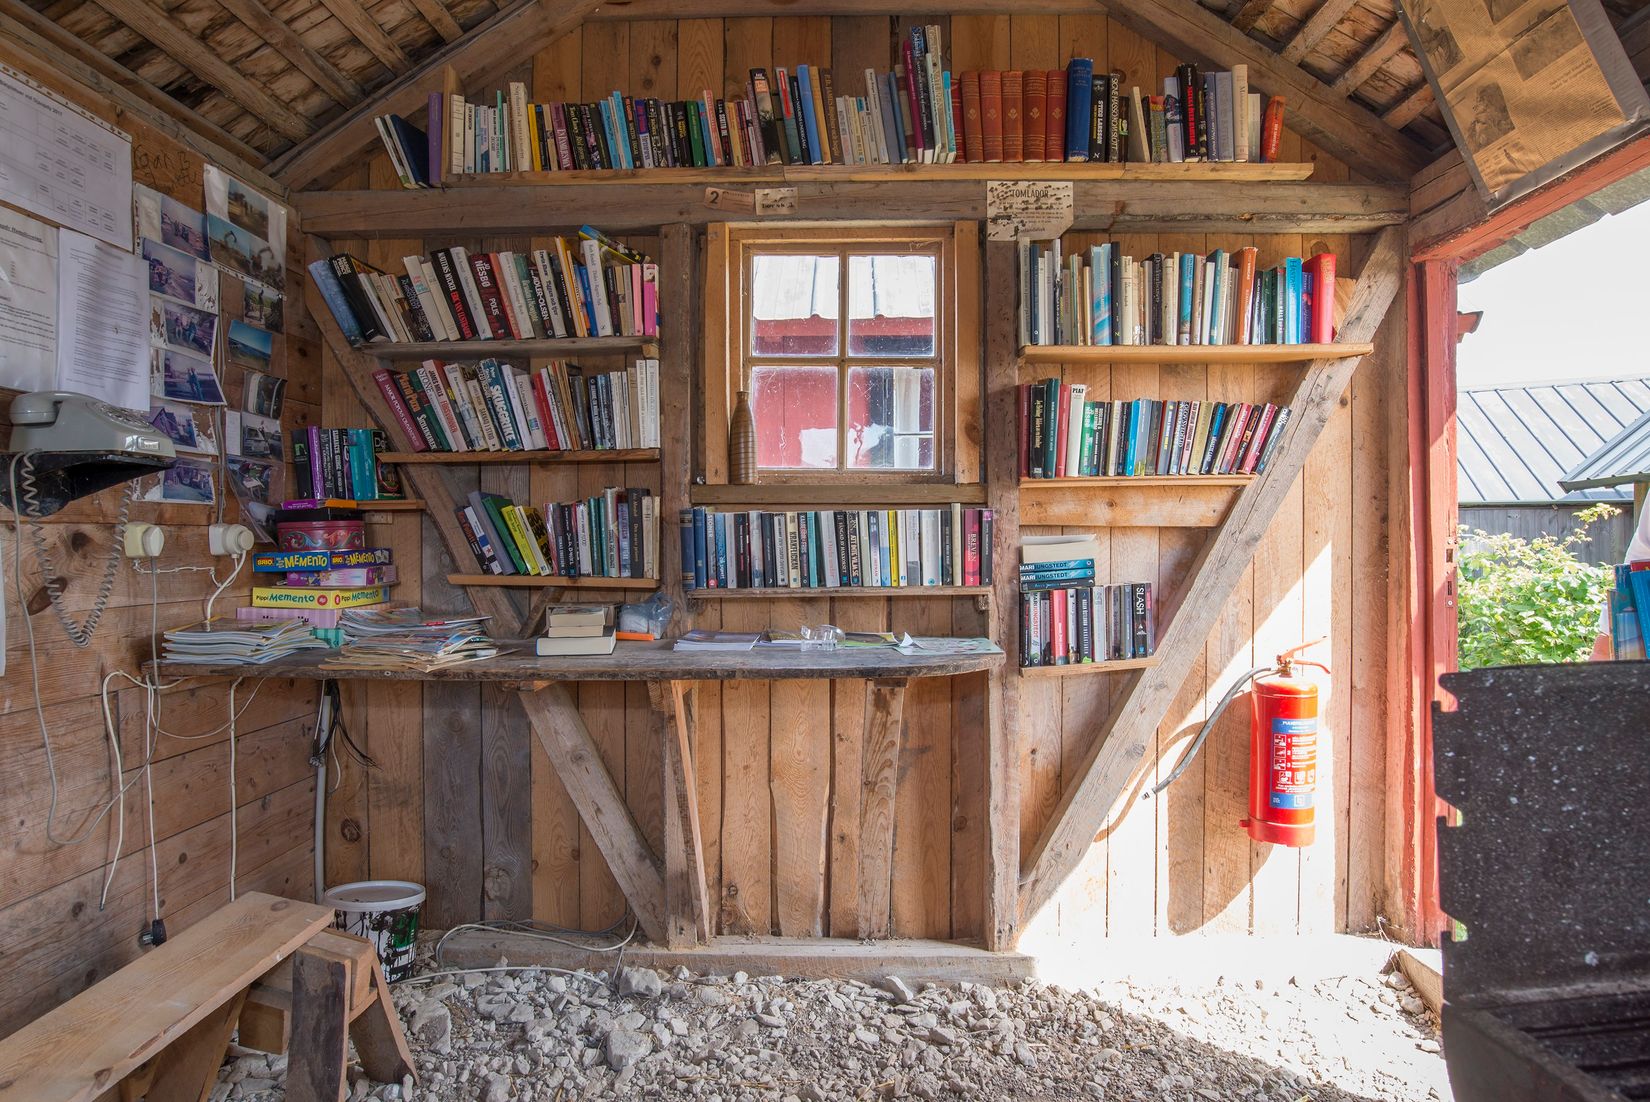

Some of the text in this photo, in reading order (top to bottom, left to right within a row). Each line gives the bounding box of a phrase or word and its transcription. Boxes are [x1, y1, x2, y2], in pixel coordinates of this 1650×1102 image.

[824, 87, 833, 105] JAMES
[571, 117, 579, 133] Clancy
[710, 191, 719, 204] 2
[483, 262, 490, 270] JO
[539, 251, 549, 276] Irwin Shaw
[475, 260, 491, 288] NESBØ
[532, 276, 549, 320] ADLER-OLSEN
[489, 297, 500, 316] POLIS
[428, 370, 437, 383] JAMES
[399, 373, 421, 412] Mario Puzo
[491, 385, 515, 441] SKUGGRIKE
[284, 554, 327, 568] MEMENTO
[349, 552, 374, 565] MEMENTO
[1034, 562, 1067, 570] JUNGSTEDT
[1035, 572, 1068, 580] JUNGSTEDT
[269, 593, 315, 603] Memento
[352, 590, 378, 601] Memento
[1136, 587, 1145, 615] SLASH
